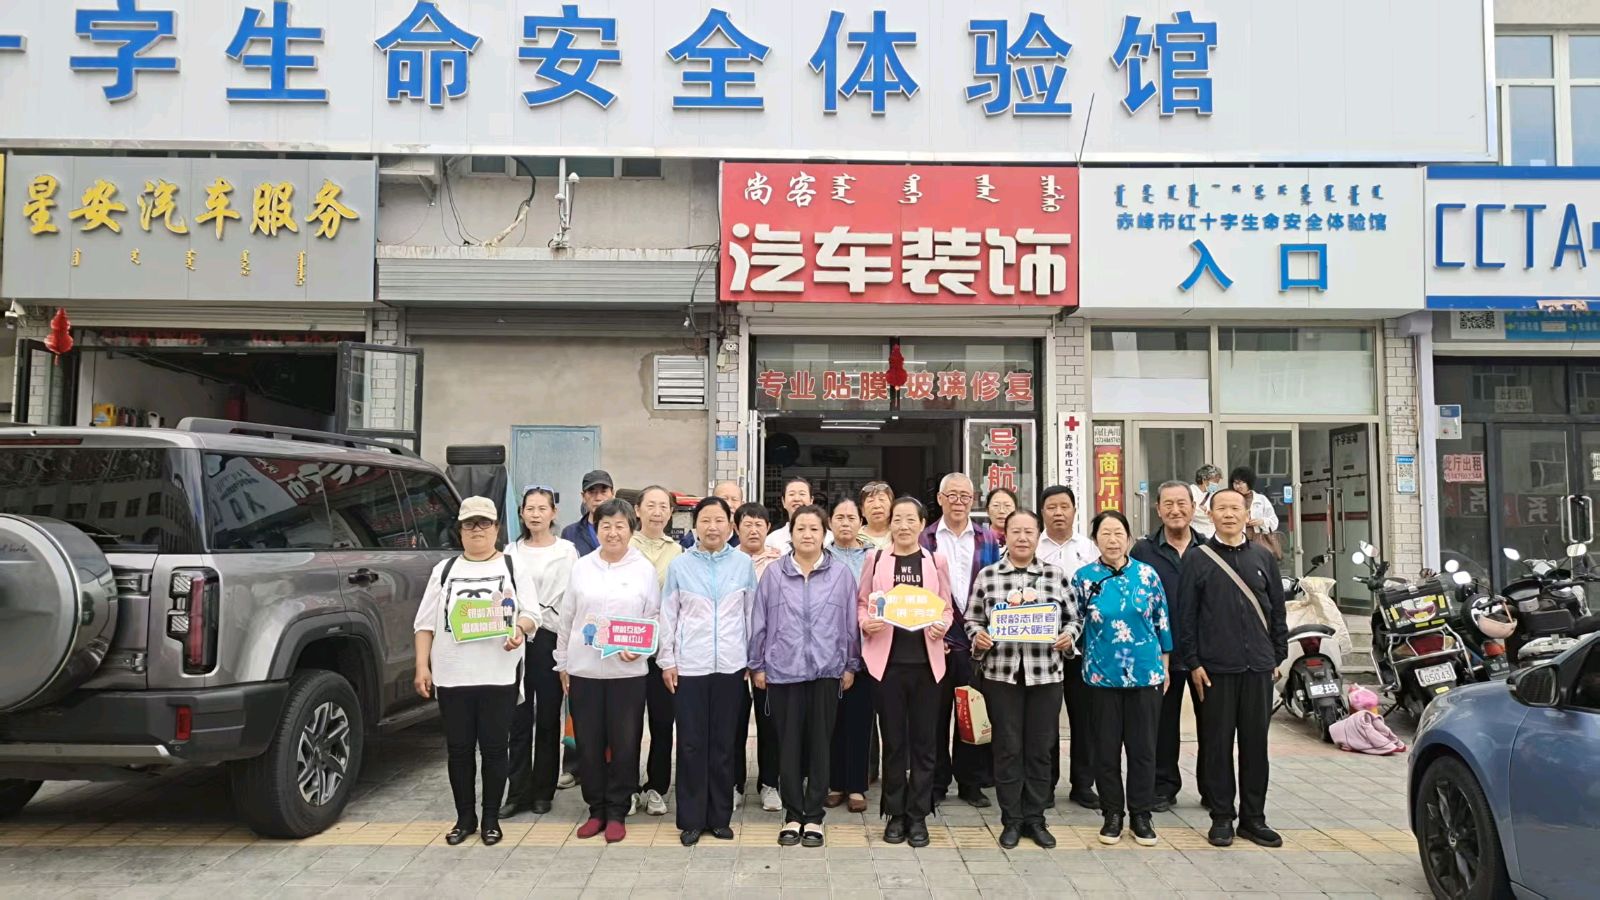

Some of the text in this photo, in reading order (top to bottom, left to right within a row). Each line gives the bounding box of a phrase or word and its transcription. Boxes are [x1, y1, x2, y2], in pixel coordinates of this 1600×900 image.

[0, 0, 1217, 117] 字生命安全体验馆
[21, 175, 359, 240] 星安汽车服务
[743, 171, 817, 208] 尚客
[1116, 212, 1387, 231] 赤峰市红十字生命安全体验馆
[728, 222, 1072, 296] 汽车装饰
[1178, 239, 1328, 293] 入口
[757, 370, 1033, 402] 专业贴膜 玻璃修复
[987, 428, 1018, 492] 导航
